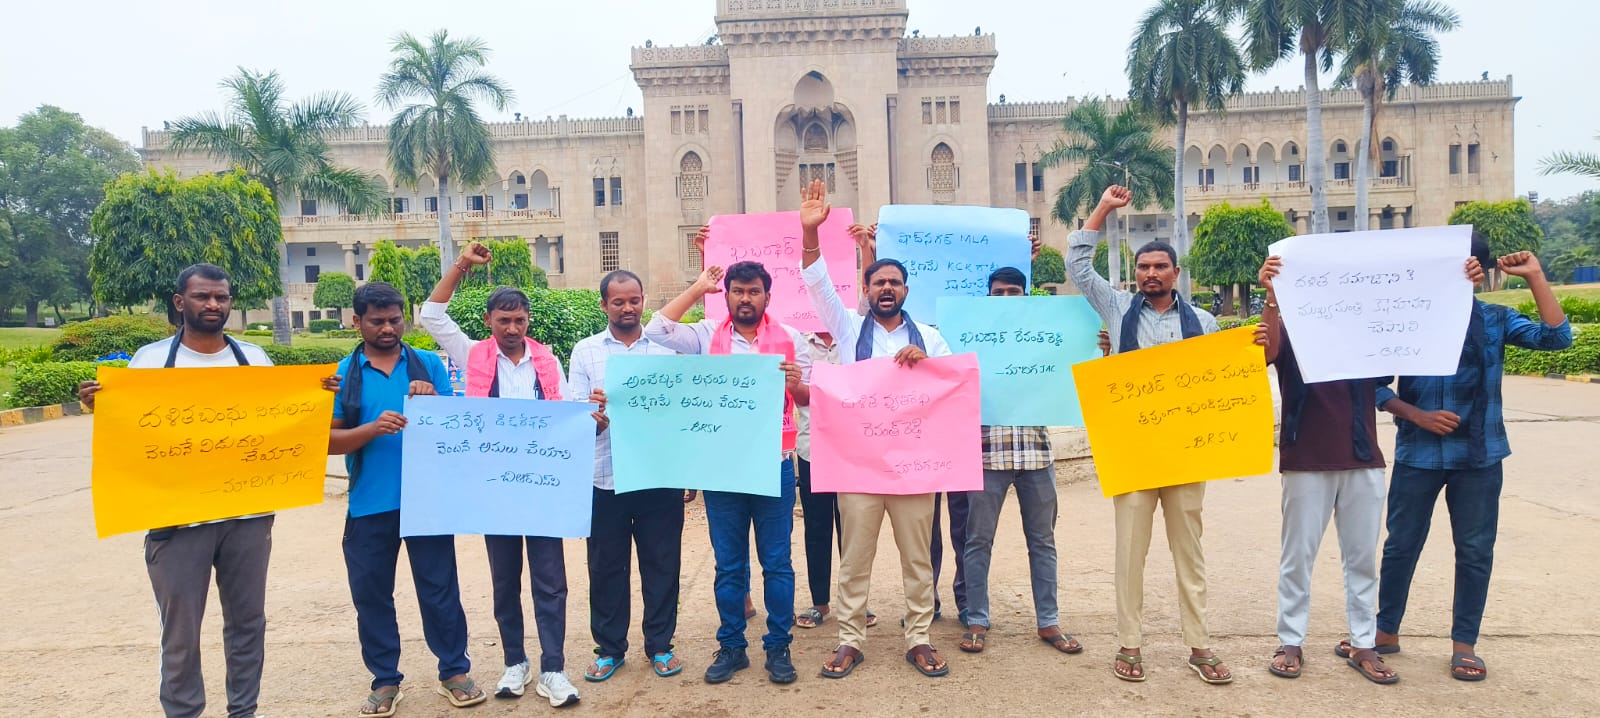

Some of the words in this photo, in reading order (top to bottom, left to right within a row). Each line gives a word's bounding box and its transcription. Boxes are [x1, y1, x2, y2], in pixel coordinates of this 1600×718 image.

[960, 234, 989, 245] MLA
[1040, 365, 1056, 373] JAC
[417, 415, 434, 426] SC
[933, 460, 952, 471] JAC
[280, 469, 313, 485] JAC
